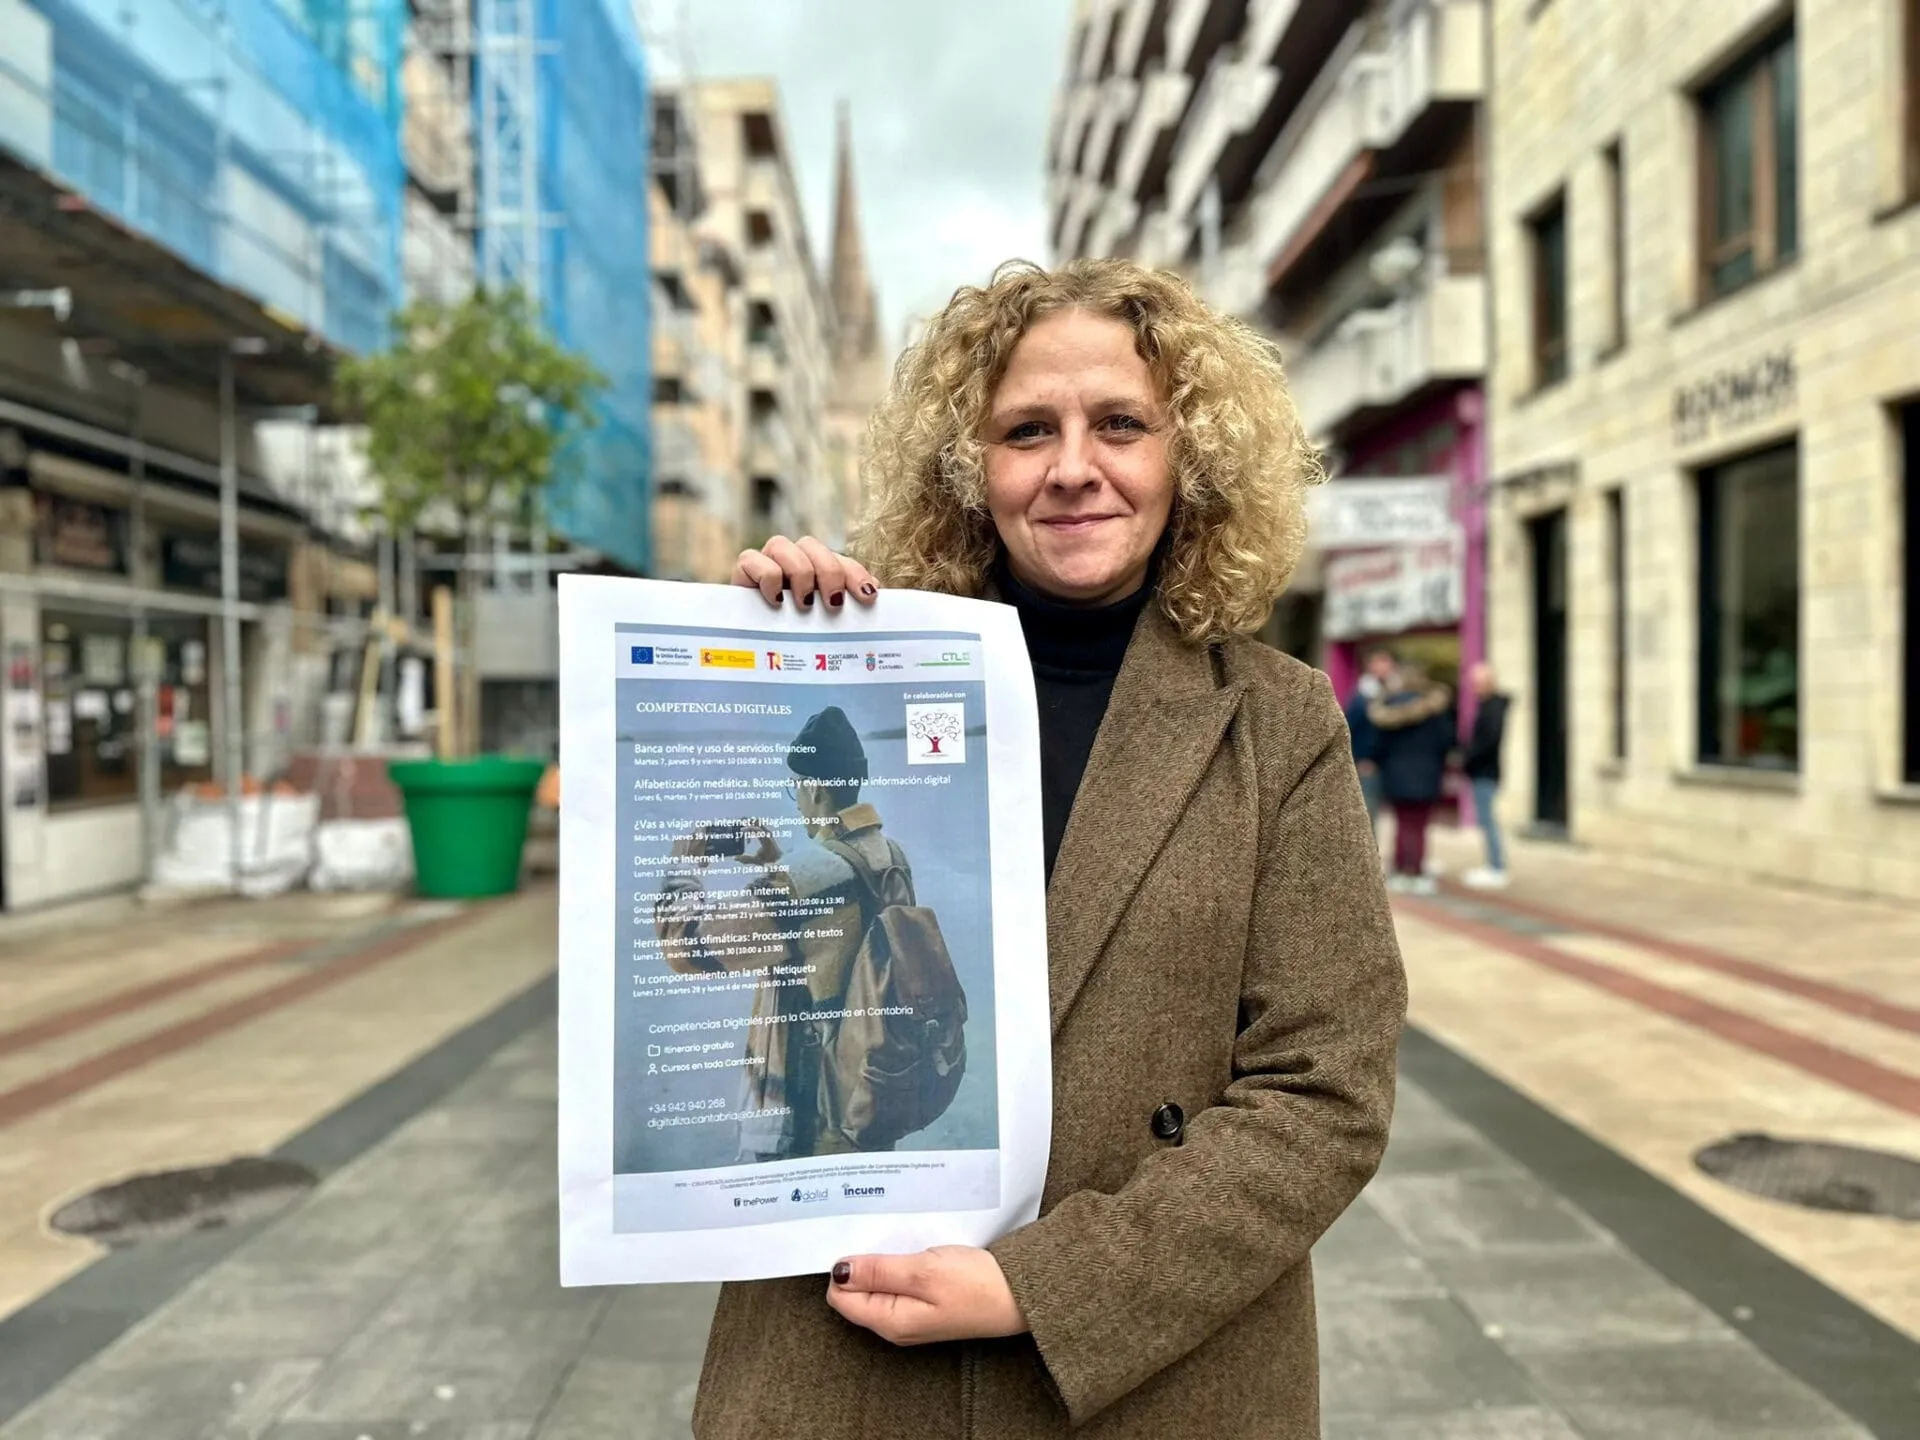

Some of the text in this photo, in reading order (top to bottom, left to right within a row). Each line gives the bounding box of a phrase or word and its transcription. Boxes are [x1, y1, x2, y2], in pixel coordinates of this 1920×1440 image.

[912, 691, 953, 700] colaboración
[636, 702, 792, 715] COMPETENCIAS DIGITALES
[634, 743, 816, 756] Banca online y uso de servicios financiero
[634, 758, 659, 766] Martes
[660, 758, 668, 767] 7,
[668, 758, 690, 767] jueves
[634, 775, 951, 790] Alfabetización mediática. Búsqueda y evaluación de la información digital
[700, 792, 724, 800] viernes
[634, 820, 656, 831] ¿Vas
[658, 821, 666, 829] a
[666, 818, 694, 831] viajar
[695, 820, 712, 828] con
[714, 817, 756, 828] internet?
[812, 816, 840, 828] seguro
[634, 834, 658, 842] Martes
[660, 834, 670, 842] 14,
[672, 834, 694, 842] jueves
[710, 832, 734, 840] viernes
[735, 832, 743, 840] 17
[634, 855, 680, 866] Descubre
[634, 870, 654, 878] Lunes
[668, 868, 690, 876] martes
[707, 868, 732, 876] viernes
[733, 866, 741, 874] 17
[634, 886, 790, 902] Compra y pago seguro en internet
[634, 906, 656, 914] Grupo
[634, 916, 656, 925] Grupo
[634, 928, 844, 949] Herramientas ofimáticas: Procesador de textos
[634, 952, 654, 961] Lunes
[655, 952, 666, 962] 27,
[667, 951, 690, 959] martes
[704, 948, 726, 959] jueves
[726, 948, 735, 956] 30
[634, 964, 817, 985] Tu comportamiento en la red. Netiqueta
[634, 990, 653, 998] Lunes
[654, 988, 665, 998] 27,
[667, 986, 690, 995] martes
[708, 984, 724, 992] lunes
[742, 982, 760, 992] mayo
[648, 1020, 720, 1034] Competencias
[723, 1016, 762, 1030] Digitales
[765, 1014, 787, 1026] para
[788, 1012, 798, 1022] la
[800, 1008, 852, 1021] Ciudadanía
[867, 1006, 914, 1016] Cantabria
[664, 1041, 734, 1054] Itinerario gratuito
[660, 1064, 690, 1072] Cursos
[704, 1060, 724, 1068] toda
[725, 1056, 766, 1067] Cantabria
[648, 1104, 666, 1114] +34
[668, 1102, 686, 1112] 942
[688, 1100, 706, 1110] 940
[844, 1185, 885, 1196] incuem
[743, 1196, 778, 1206] thePower
